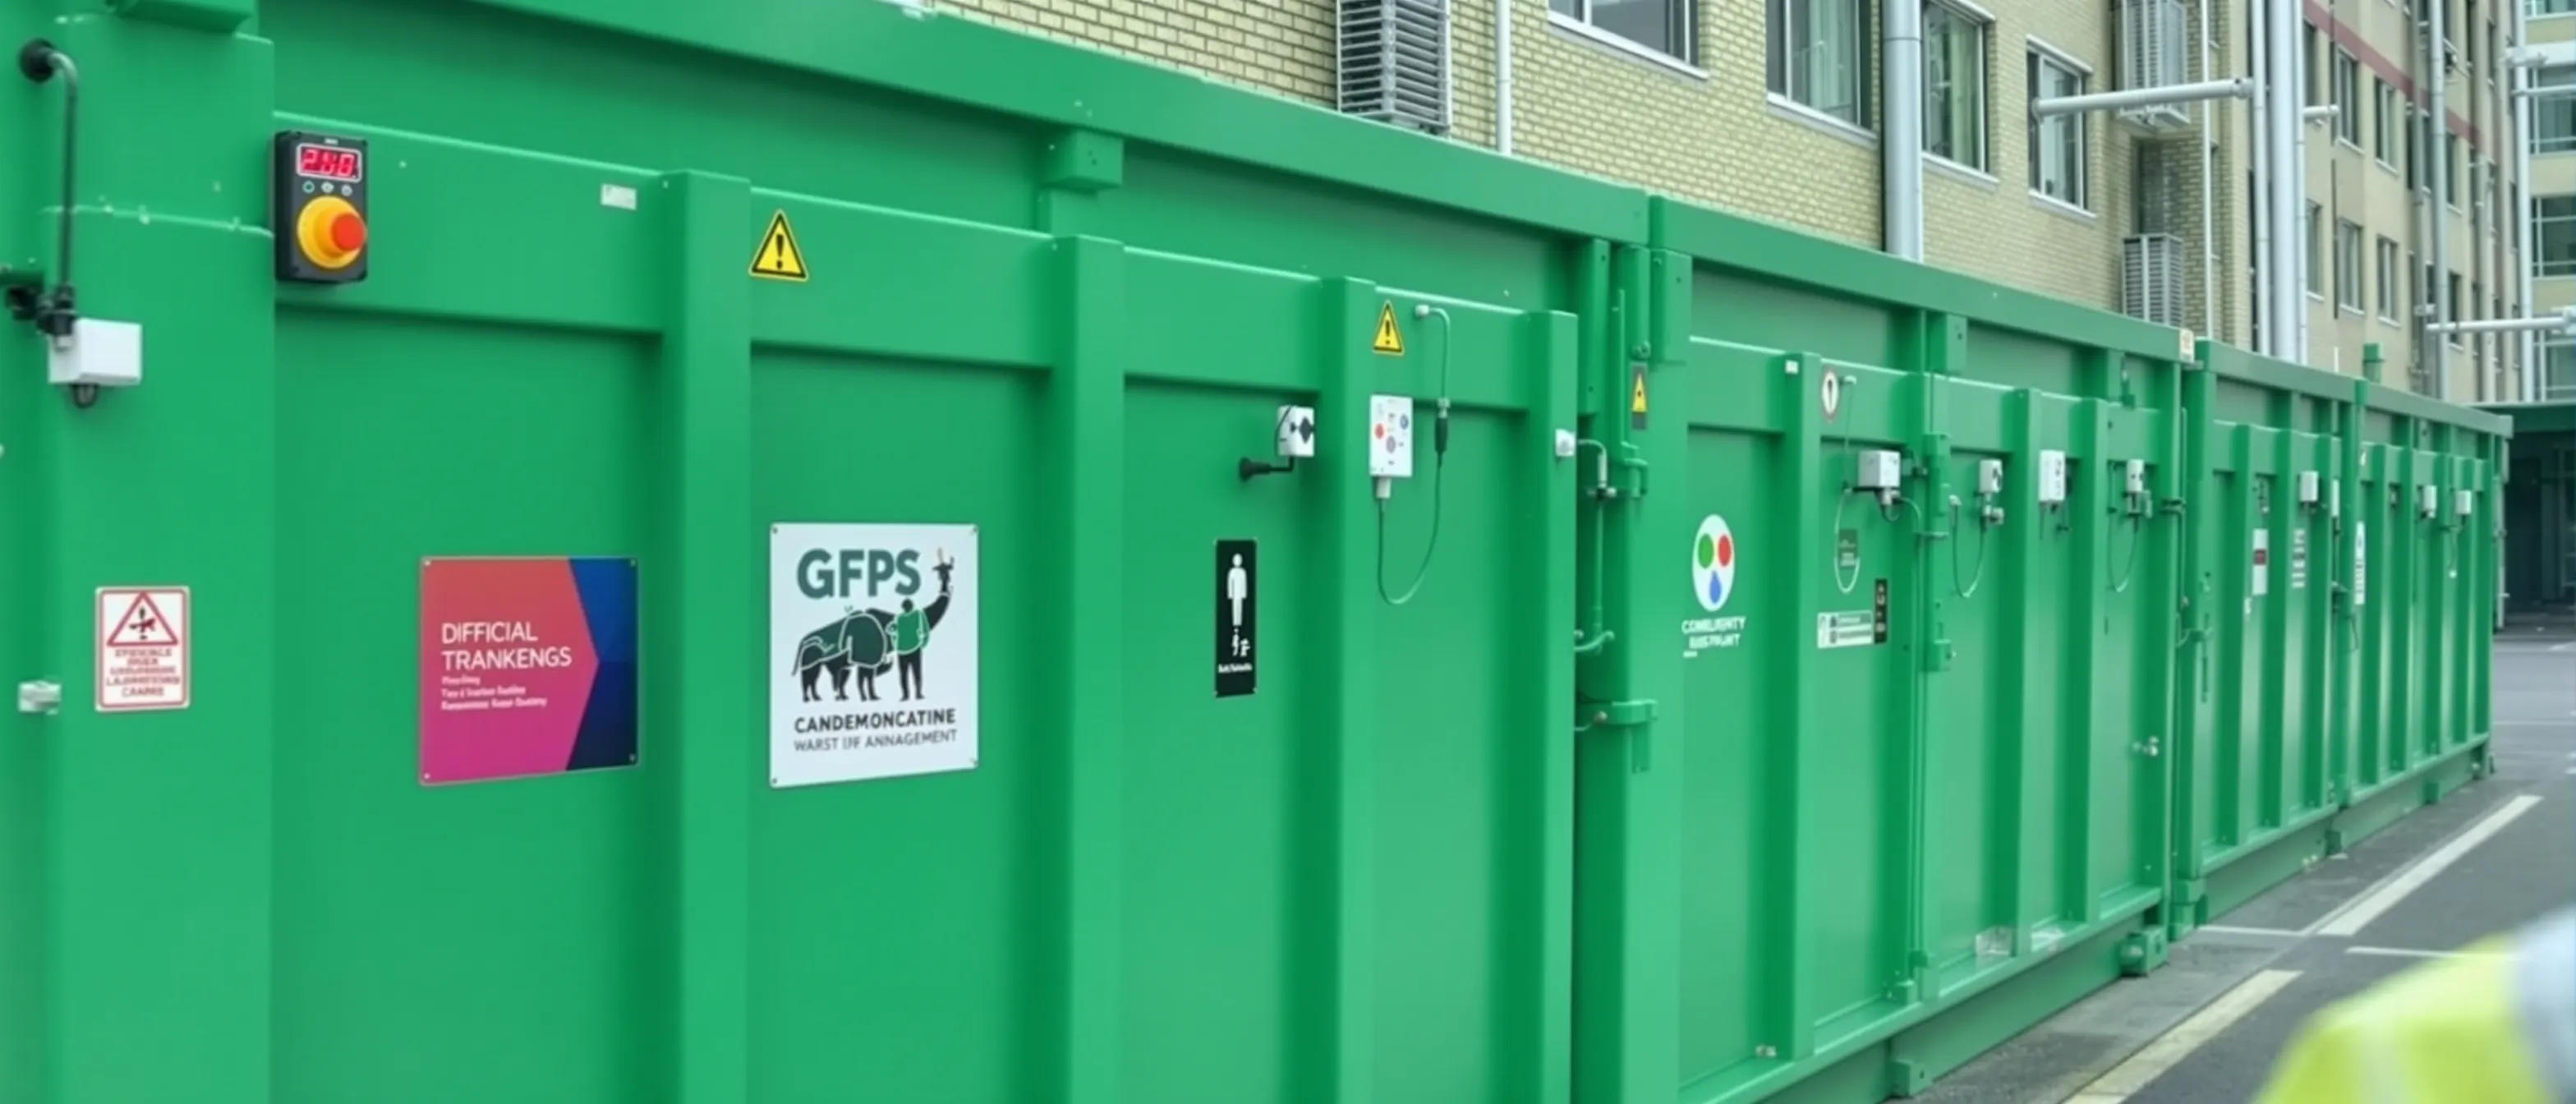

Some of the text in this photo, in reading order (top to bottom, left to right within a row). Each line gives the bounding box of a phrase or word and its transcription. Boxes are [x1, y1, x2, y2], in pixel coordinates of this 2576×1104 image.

[796, 548, 922, 600] GFPS
[441, 621, 538, 645] DIFFICIAL
[441, 646, 573, 671] TRANKENGS
[794, 708, 956, 734] CANDEMONCATINE
